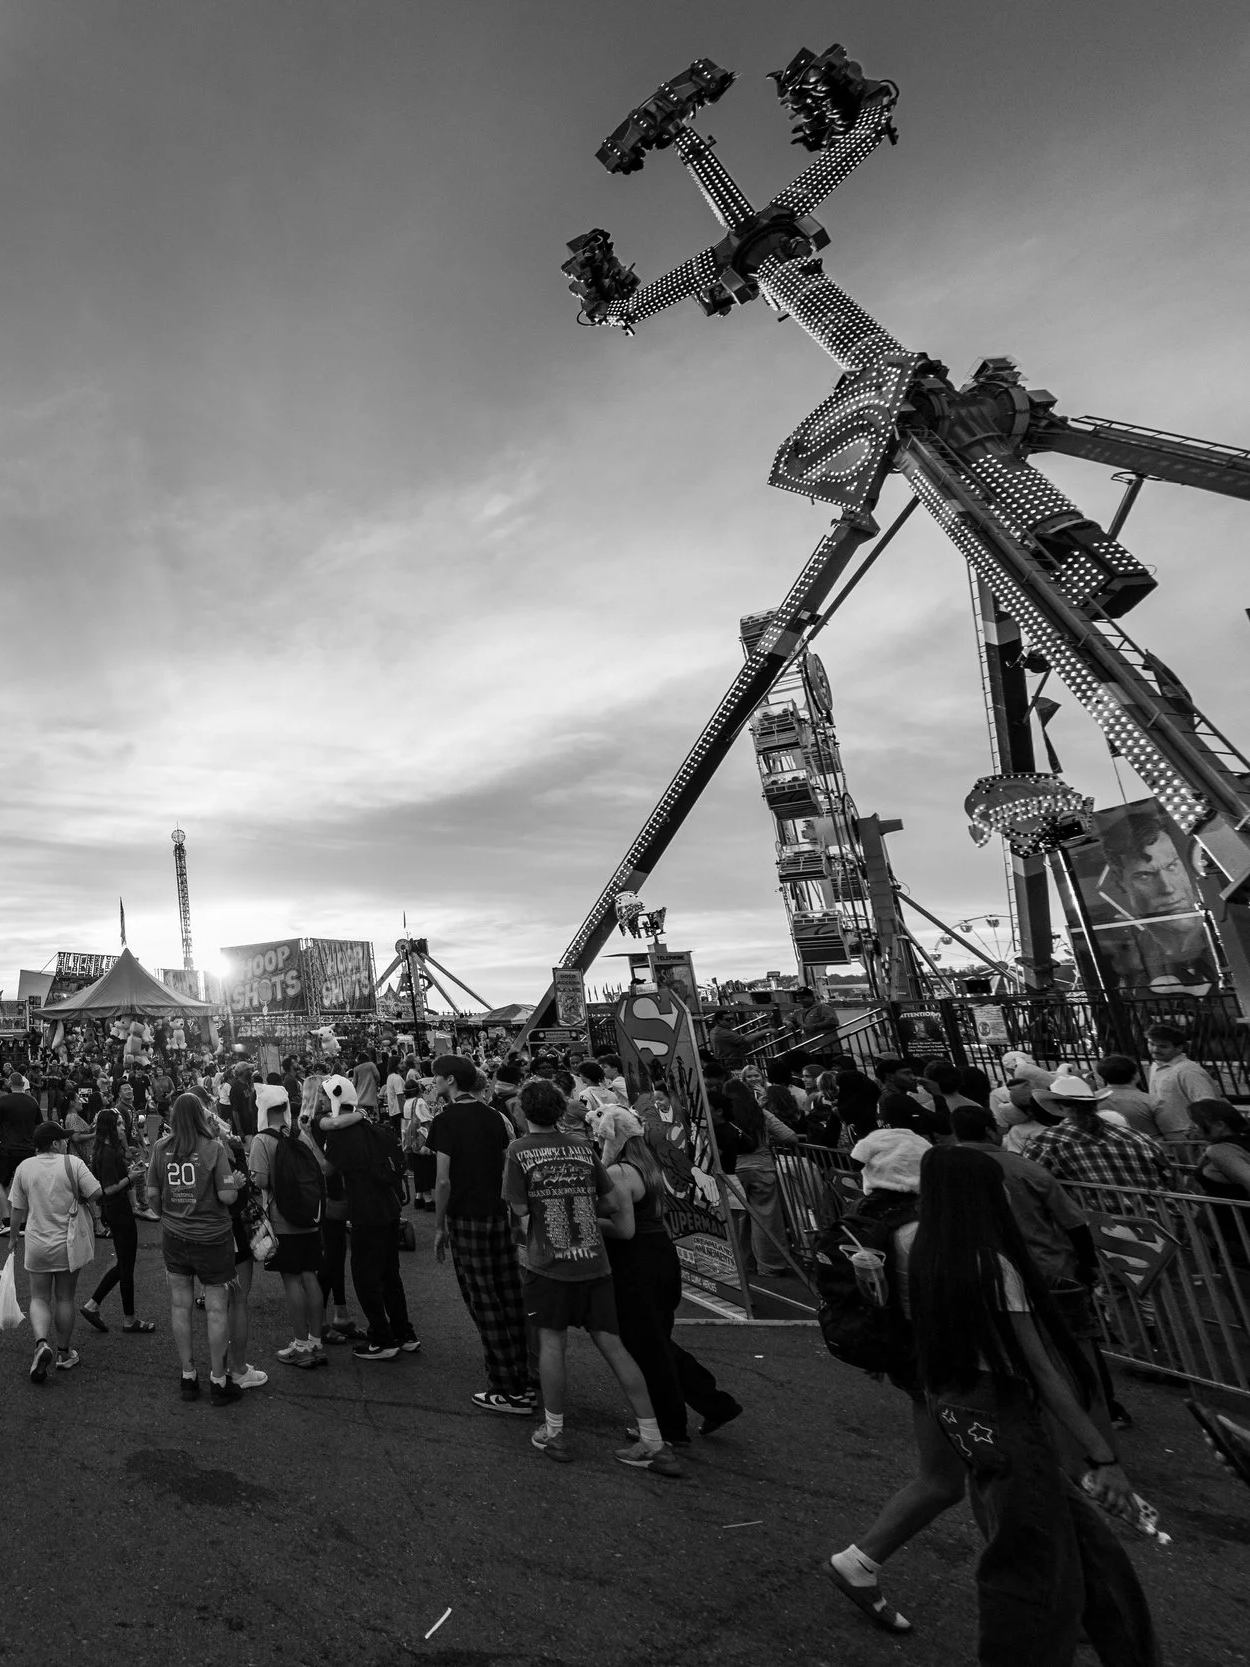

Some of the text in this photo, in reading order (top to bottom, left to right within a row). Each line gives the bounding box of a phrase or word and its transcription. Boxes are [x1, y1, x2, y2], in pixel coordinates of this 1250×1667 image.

[240, 944, 290, 980] HOOP
[230, 969, 302, 1012] SHOTS
[166, 1162, 196, 1185] 20
[666, 1211, 727, 1239] UPERMAN
